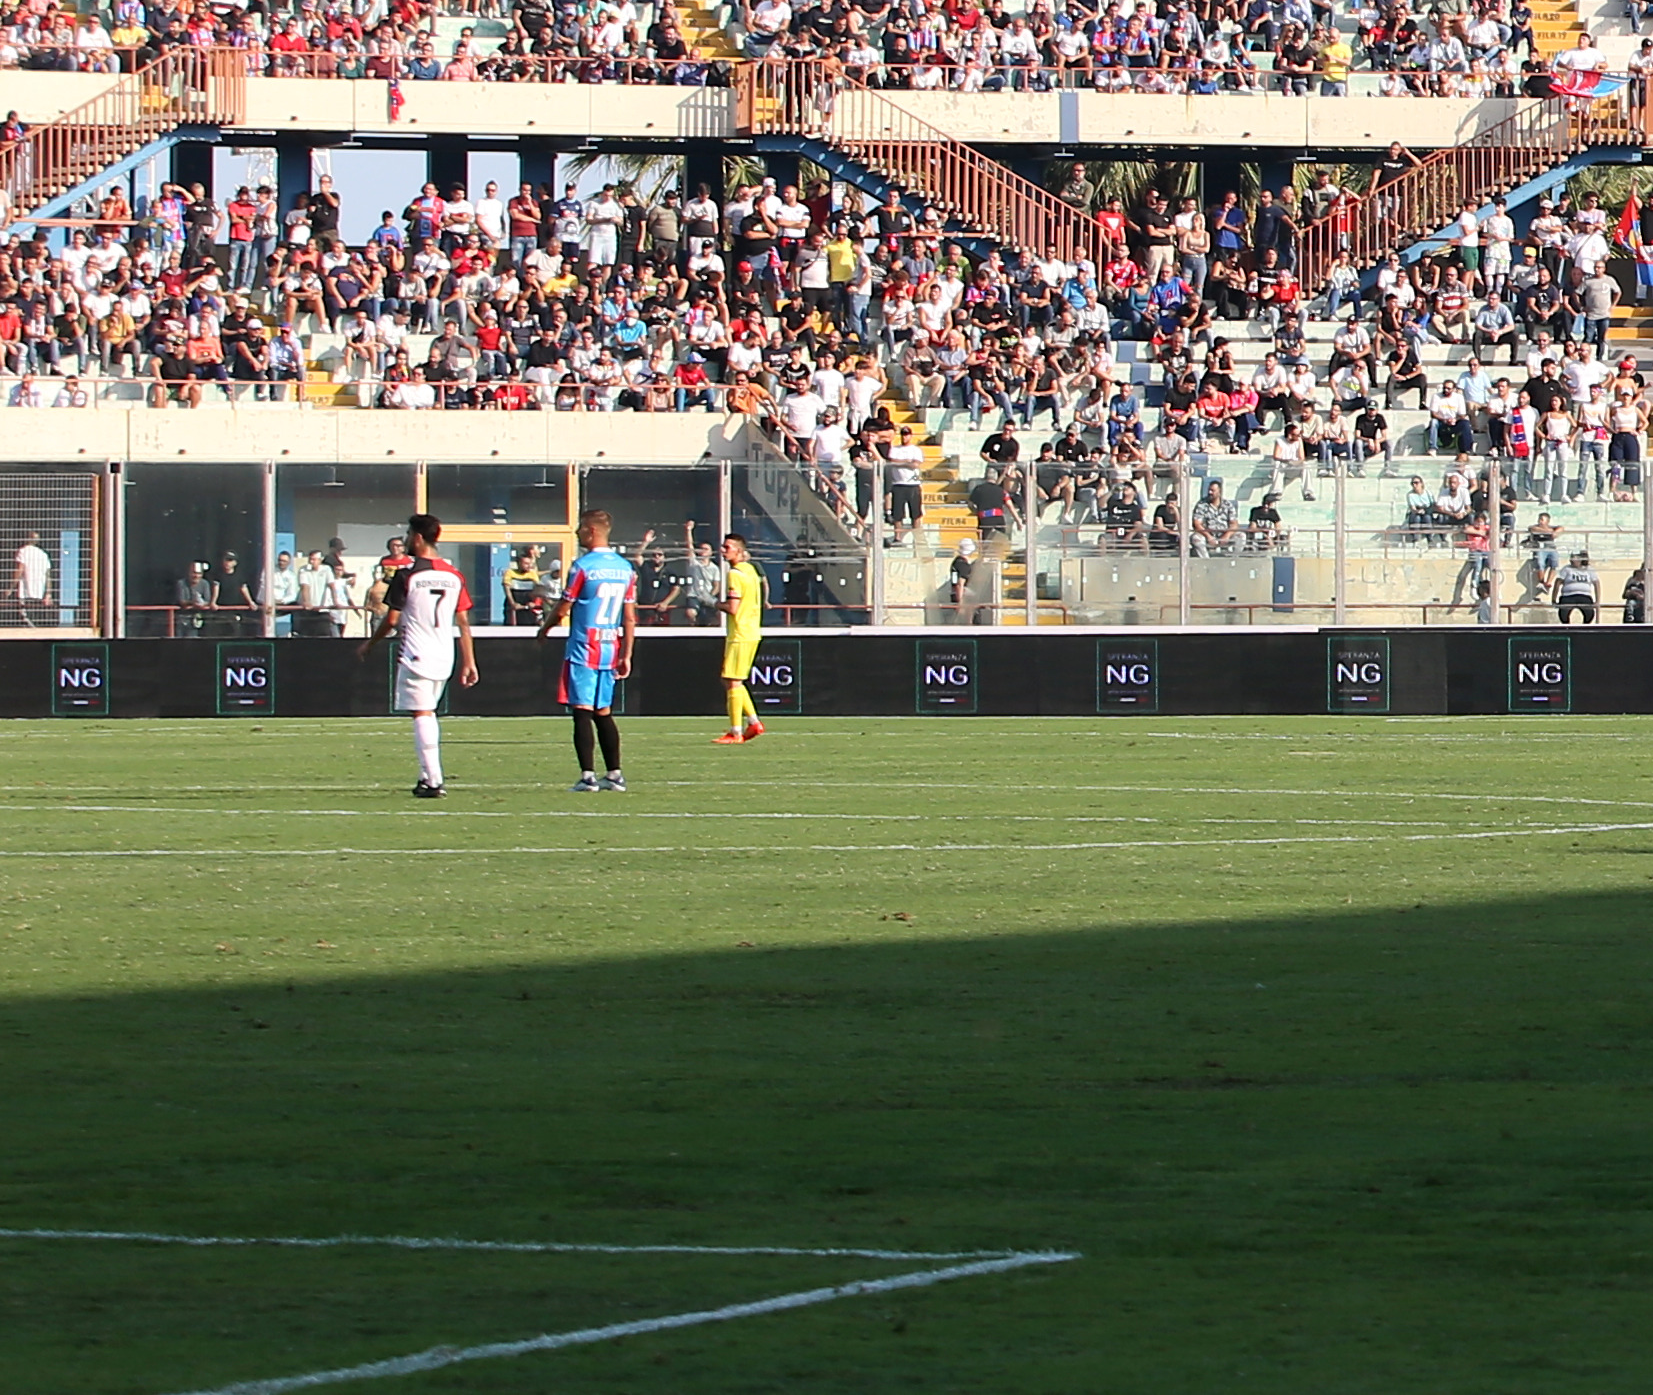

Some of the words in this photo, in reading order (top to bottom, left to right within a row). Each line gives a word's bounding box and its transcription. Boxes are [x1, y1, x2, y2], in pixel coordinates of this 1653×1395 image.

[429, 589, 446, 628] 7
[594, 581, 626, 625] 27
[60, 668, 101, 688] NG
[225, 667, 267, 687] NG
[751, 666, 793, 686] NG
[924, 665, 969, 685] NG
[1106, 664, 1150, 684] NG
[1336, 663, 1382, 684] NG
[1518, 663, 1563, 684] NG
